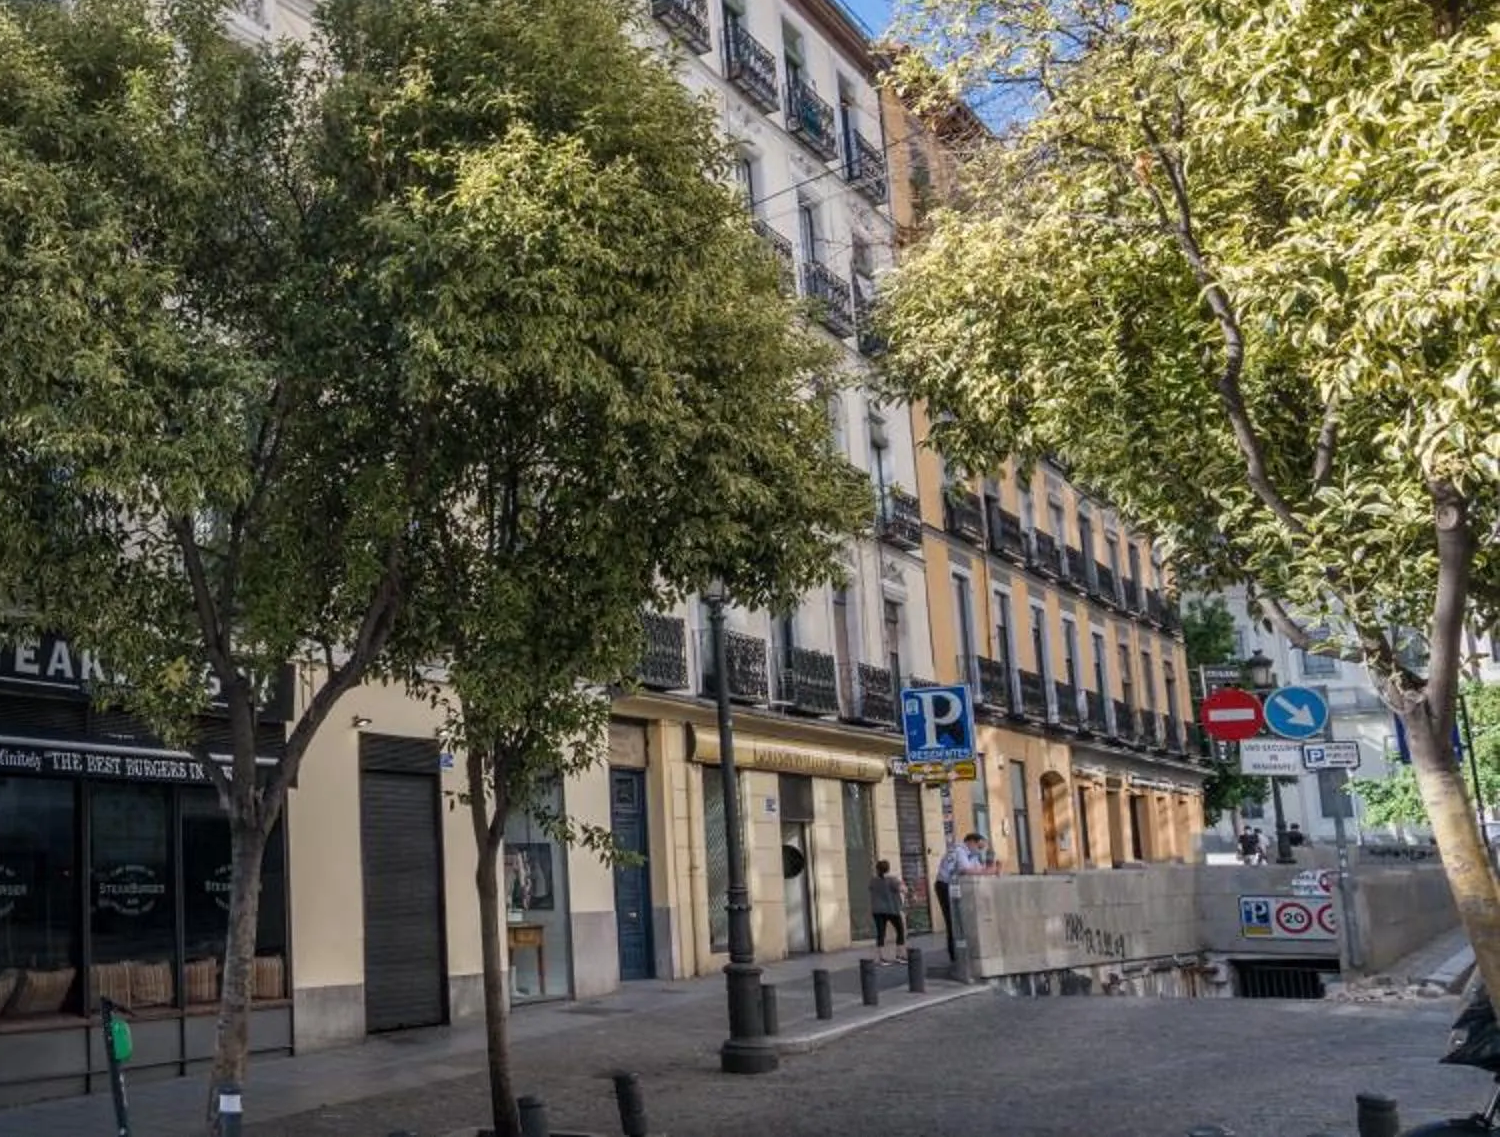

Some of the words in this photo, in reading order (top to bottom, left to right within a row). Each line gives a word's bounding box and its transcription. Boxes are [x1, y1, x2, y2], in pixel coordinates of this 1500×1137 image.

[913, 690, 963, 750] P
[87, 753, 121, 774] BEST
[126, 758, 187, 779] BURGERS
[1308, 749, 1323, 763] P
[1283, 912, 1305, 924] 20
